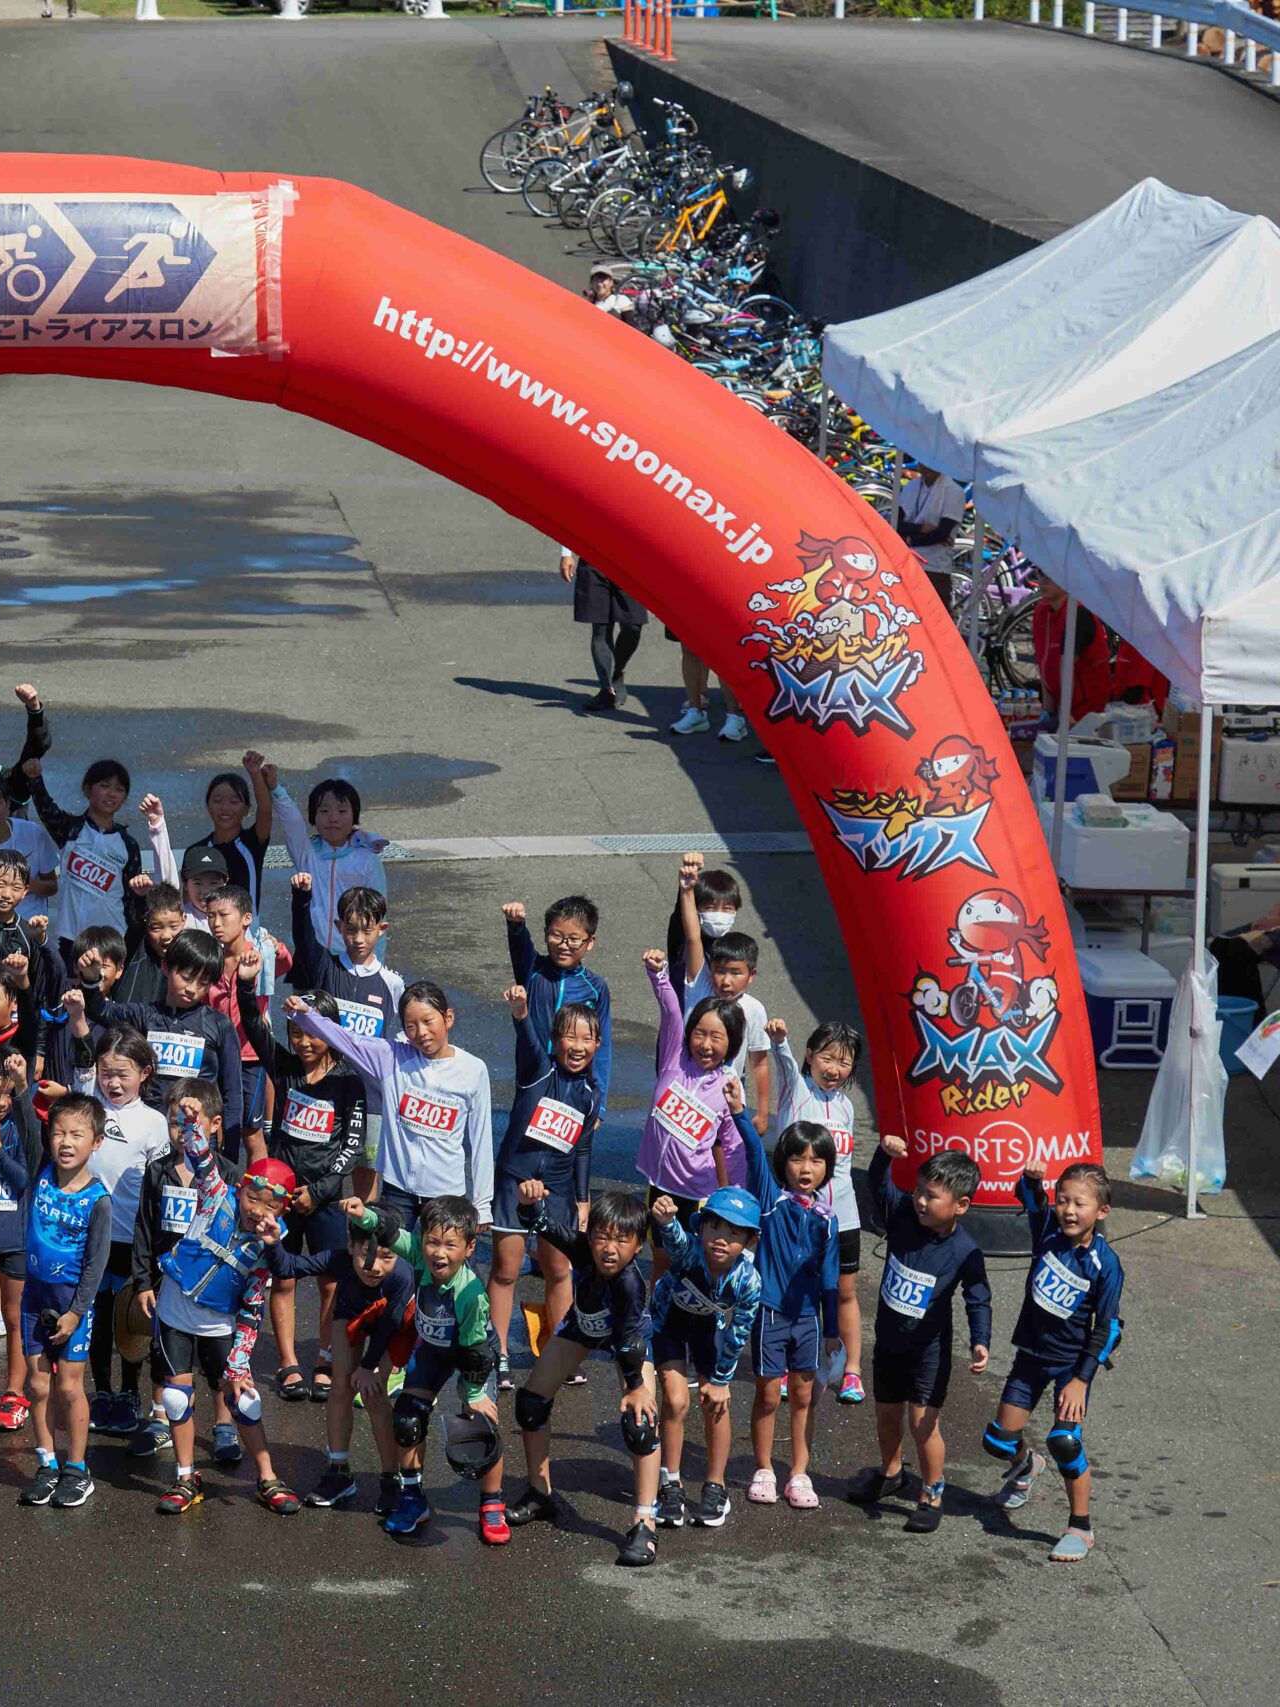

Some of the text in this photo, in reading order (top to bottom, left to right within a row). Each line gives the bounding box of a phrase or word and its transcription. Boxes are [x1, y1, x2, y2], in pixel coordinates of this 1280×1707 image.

[372, 296, 773, 565] http://www.spomax.jp
[770, 631, 909, 664] ジャンピング
[768, 655, 914, 733] MAX
[71, 856, 110, 888] C604
[152, 1042, 196, 1067] B401
[910, 1009, 1060, 1086] MAX
[350, 1100, 364, 1128] LIFE
[403, 1095, 452, 1128] B403
[661, 1093, 708, 1136] B304
[938, 1079, 1031, 1117] Rider
[285, 1101, 329, 1131] B404
[536, 1108, 579, 1142] B401
[347, 1133, 360, 1146] IS
[834, 1132, 850, 1153] 01
[164, 1198, 197, 1222] A21
[884, 1267, 926, 1306] A205
[1034, 1265, 1081, 1308] A206
